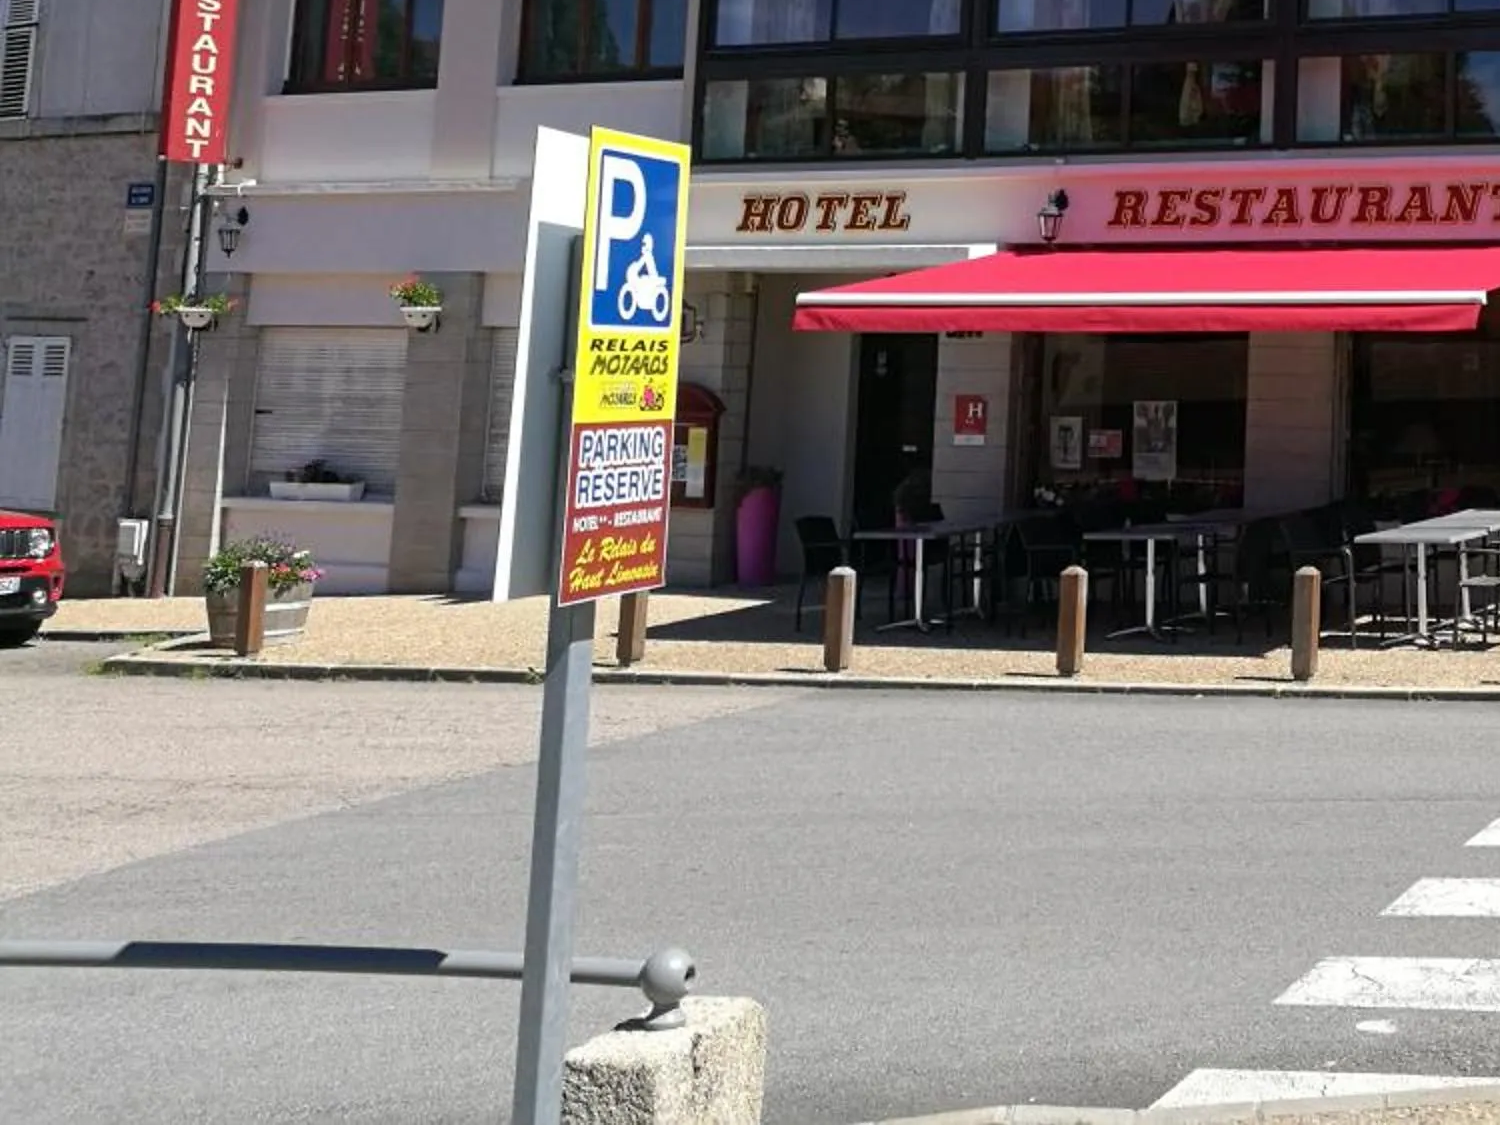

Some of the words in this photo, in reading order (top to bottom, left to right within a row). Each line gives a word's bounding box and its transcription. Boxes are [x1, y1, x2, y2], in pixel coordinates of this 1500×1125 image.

[595, 154, 648, 293] P
[736, 190, 912, 232] HOTEL
[590, 339, 669, 353] RELAIS
[589, 355, 669, 375] MOTARDS
[968, 403, 983, 419] H
[581, 430, 663, 465] PARKING
[576, 538, 596, 565] Le
[600, 534, 637, 562] Relais
[640, 531, 656, 554] du
[569, 567, 605, 593] Haut
[605, 559, 658, 586] Limousin
